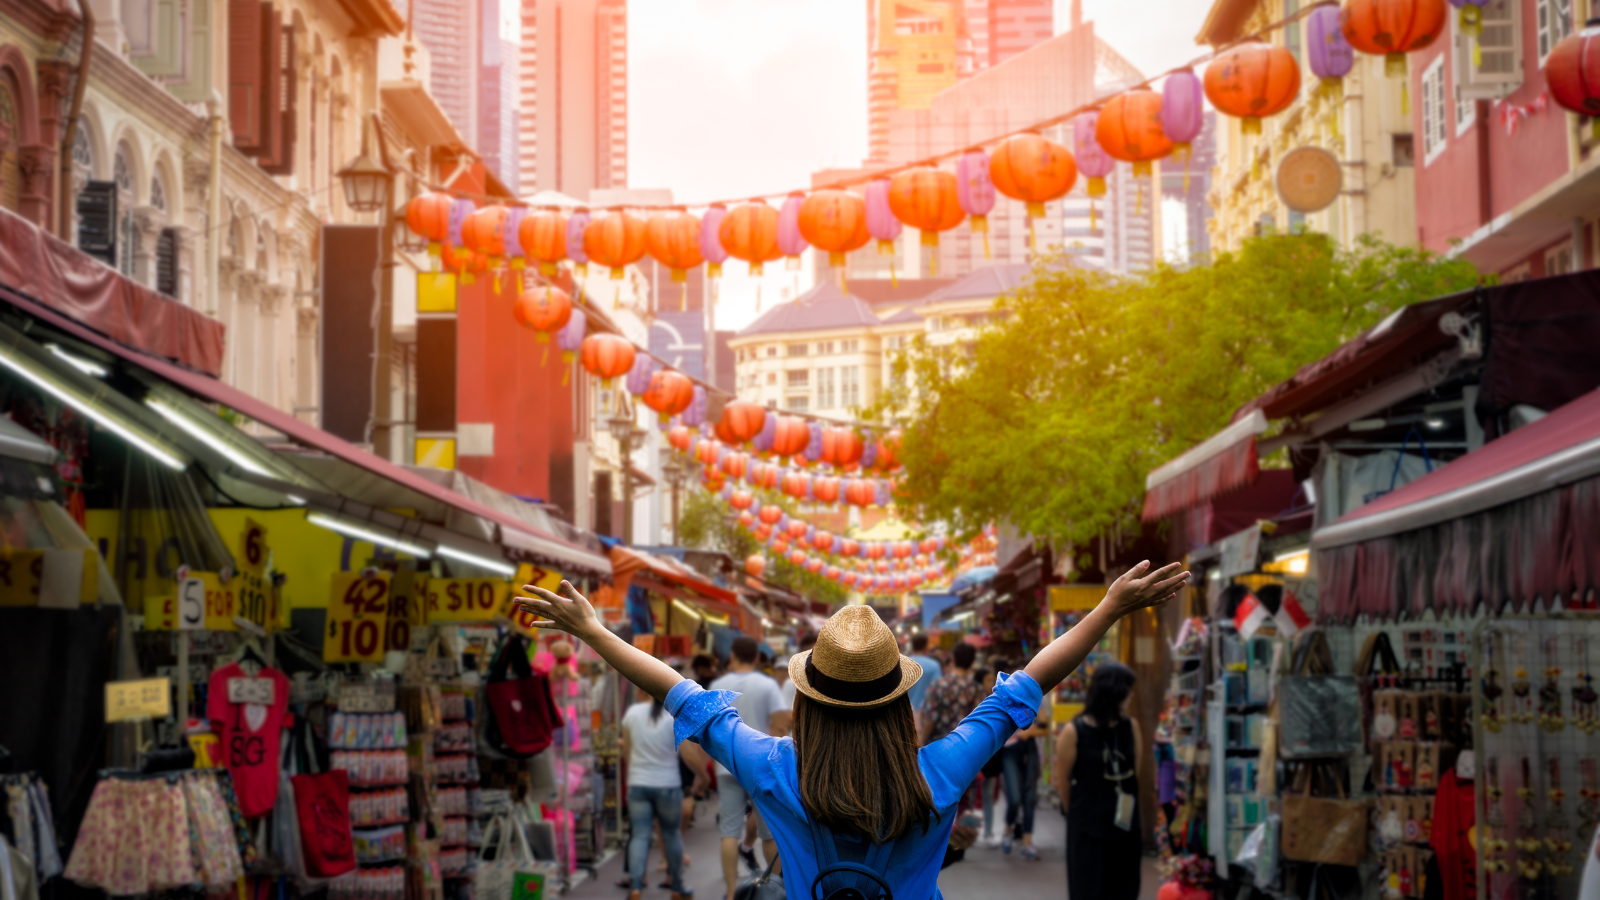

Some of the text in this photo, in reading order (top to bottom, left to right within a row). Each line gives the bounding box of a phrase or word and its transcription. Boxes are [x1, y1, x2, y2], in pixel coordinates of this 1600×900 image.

[245, 527, 262, 565] 6
[184, 580, 202, 625] 5
[206, 590, 234, 617] FOR
[343, 579, 387, 614] 42
[446, 582, 495, 612] $10
[230, 736, 267, 767] SG
